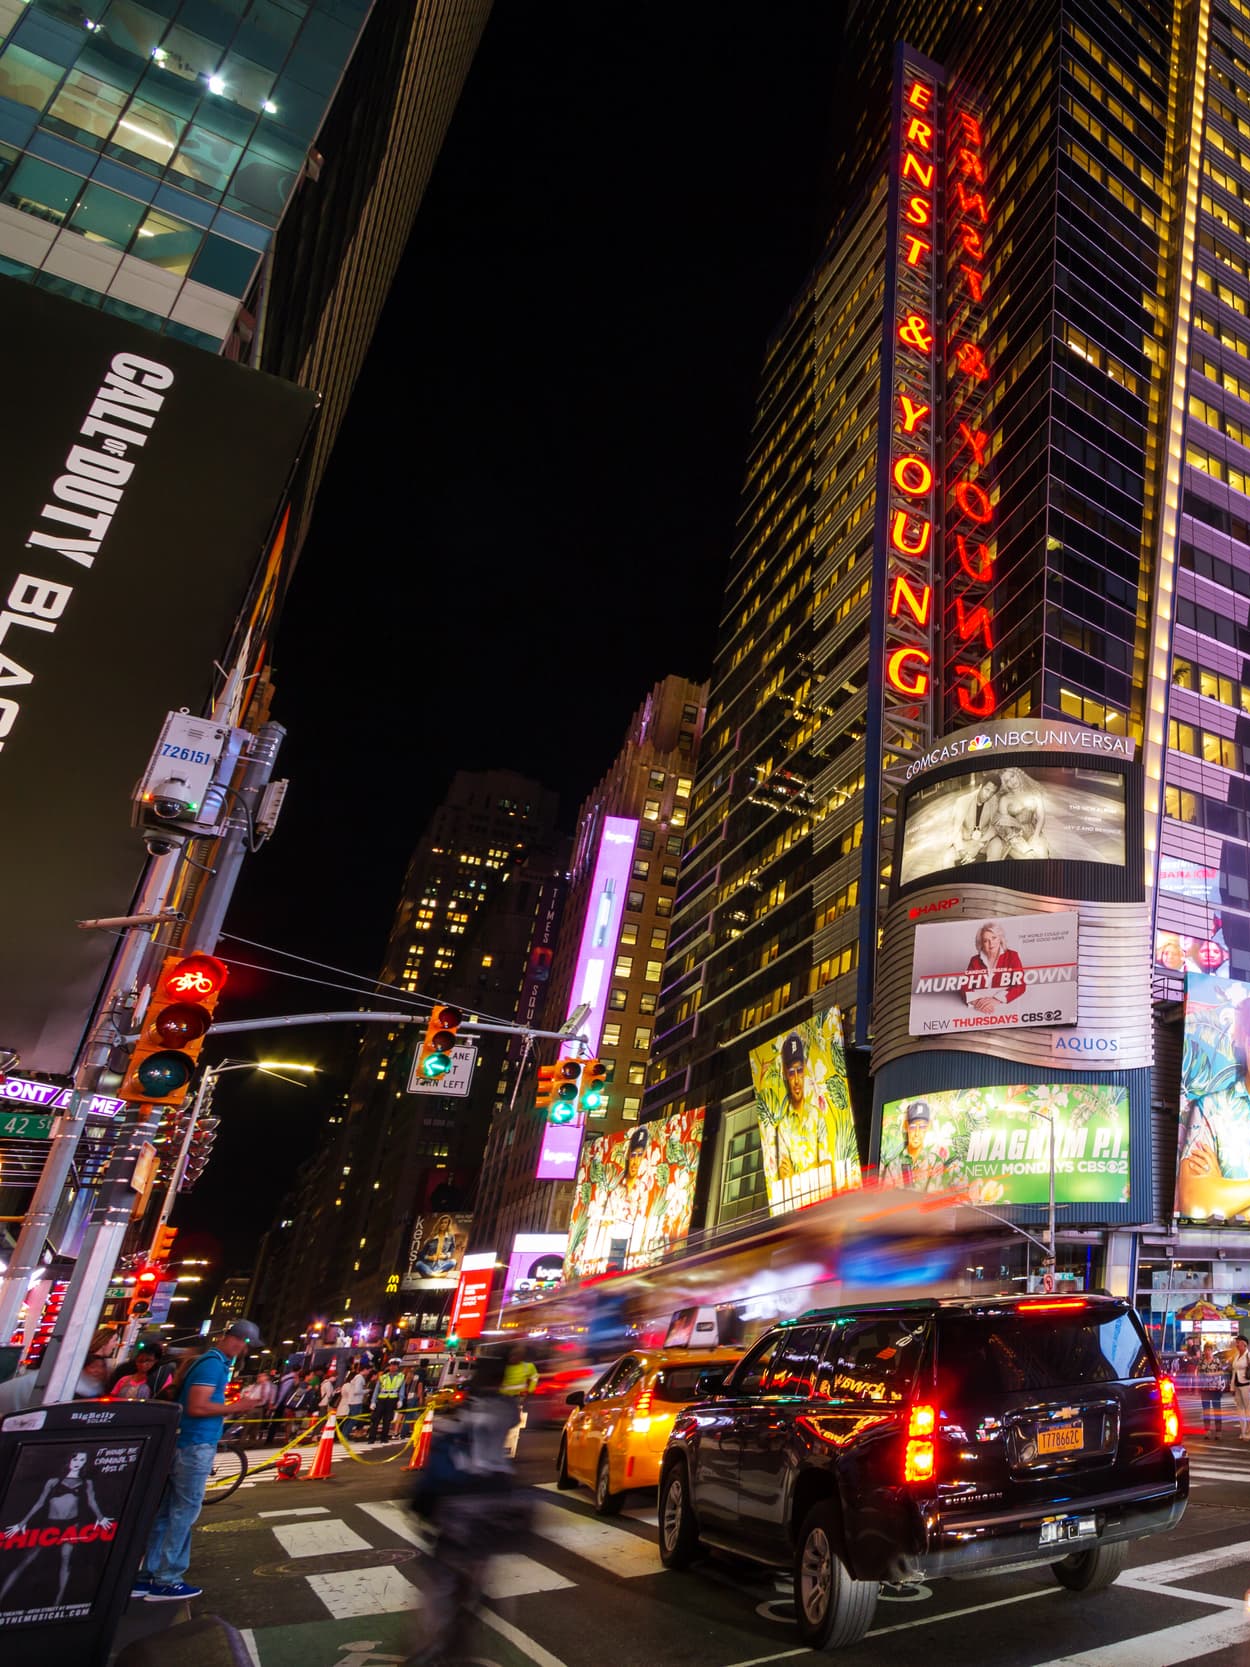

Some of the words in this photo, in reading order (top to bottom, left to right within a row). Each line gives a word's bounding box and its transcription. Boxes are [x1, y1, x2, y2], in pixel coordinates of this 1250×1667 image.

[902, 81, 934, 268] ERNST
[898, 313, 935, 351] &
[80, 352, 174, 447] CALL
[102, 438, 127, 457] OF
[26, 444, 135, 568] DUTY
[887, 395, 933, 696] YOUNG
[0, 573, 73, 750] BLA
[161, 743, 211, 765] 726151
[906, 739, 968, 780] COMCAST
[994, 730, 1135, 755] NBCUNIVERSAL
[543, 888, 559, 944] TIMES
[916, 972, 994, 993] MURPHY
[1000, 967, 1074, 987] BROWN
[923, 1019, 950, 1031] NEW
[952, 1014, 1018, 1028] THURSDAYS
[1055, 1037, 1118, 1051] AQUOS
[452, 1052, 471, 1061] ANE
[443, 1080, 465, 1089] LEFT
[62, 1092, 118, 1114] PME
[4, 1117, 29, 1134] 42
[966, 1128, 1088, 1162] MAGNUM
[1092, 1128, 1128, 1159] P.I.
[965, 1164, 999, 1177] NEW
[71, 1411, 116, 1421] BigBelly
[1042, 1429, 1079, 1449] T778662C
[0, 1521, 119, 1550] HICAGO
